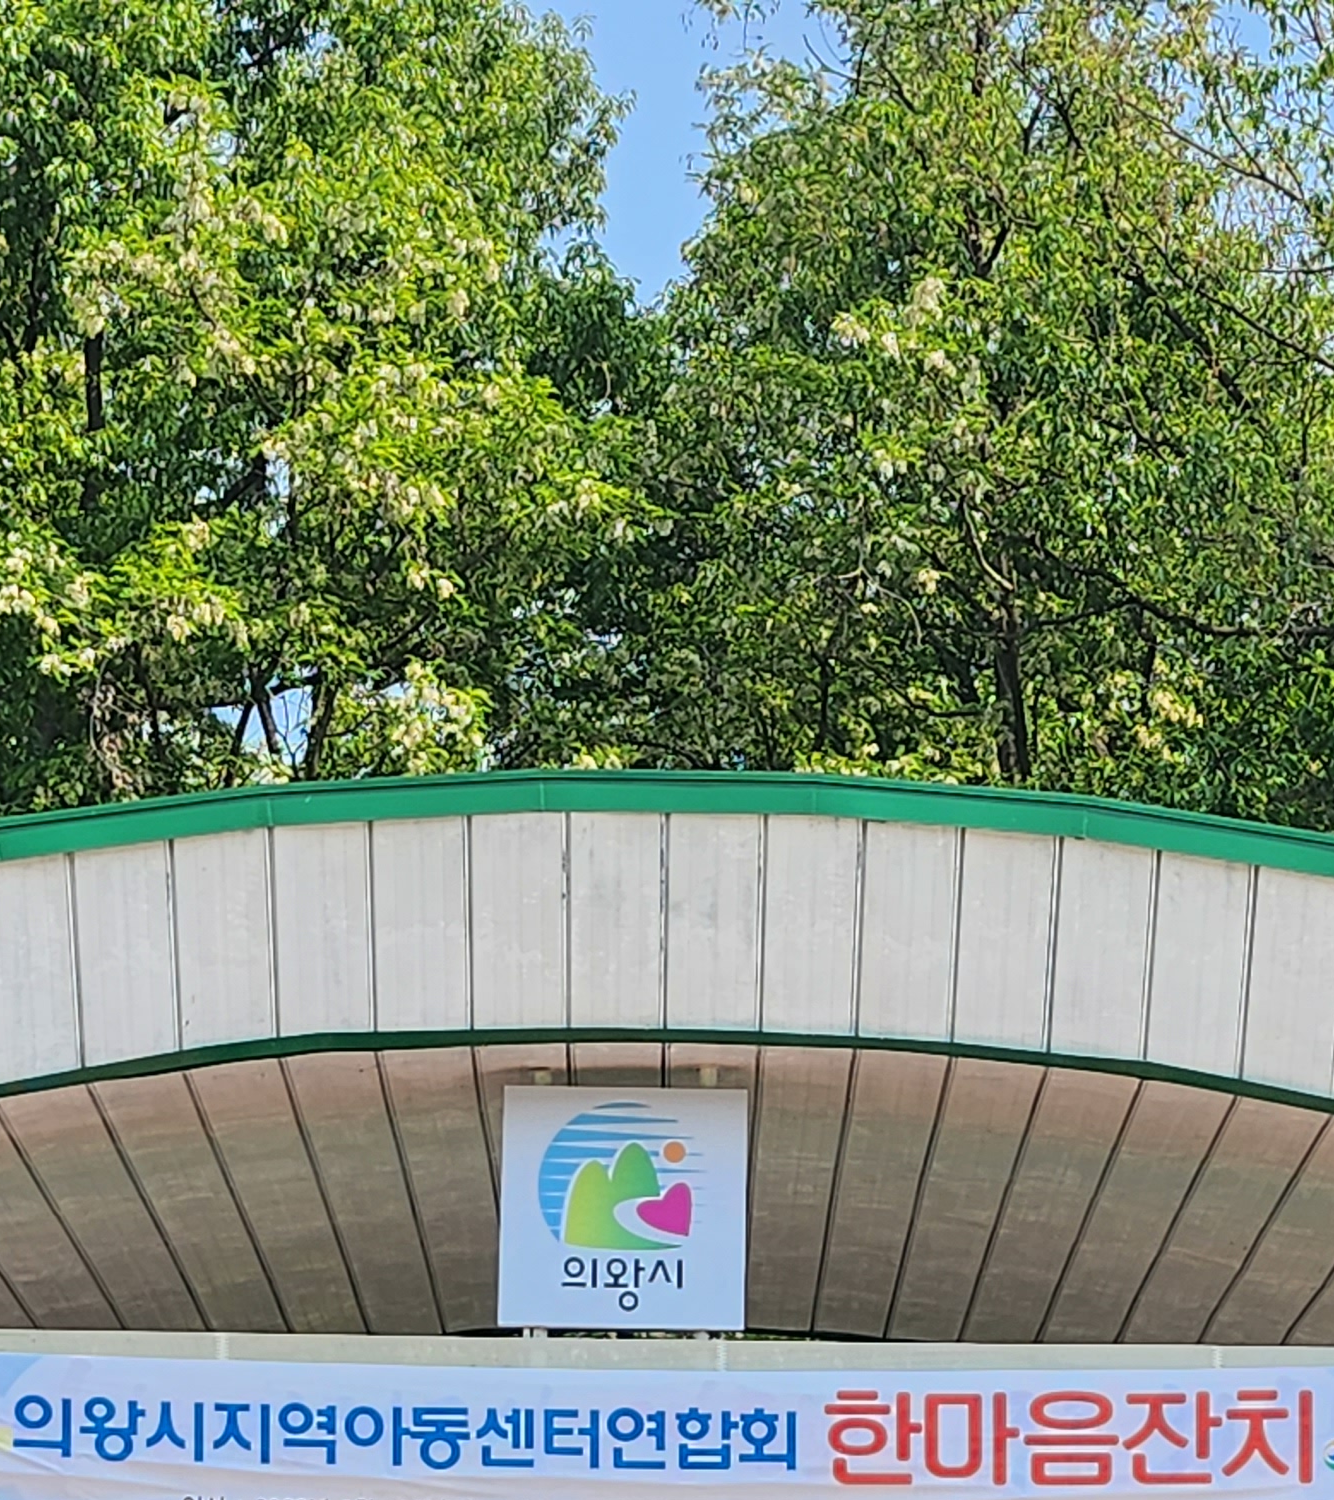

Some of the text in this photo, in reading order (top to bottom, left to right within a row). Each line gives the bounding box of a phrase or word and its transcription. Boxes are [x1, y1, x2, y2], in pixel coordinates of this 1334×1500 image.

[561, 1256, 684, 1312] 의왕시
[12, 1388, 1314, 1487] 의왕시지역아동센터연합회 한마음잔치
